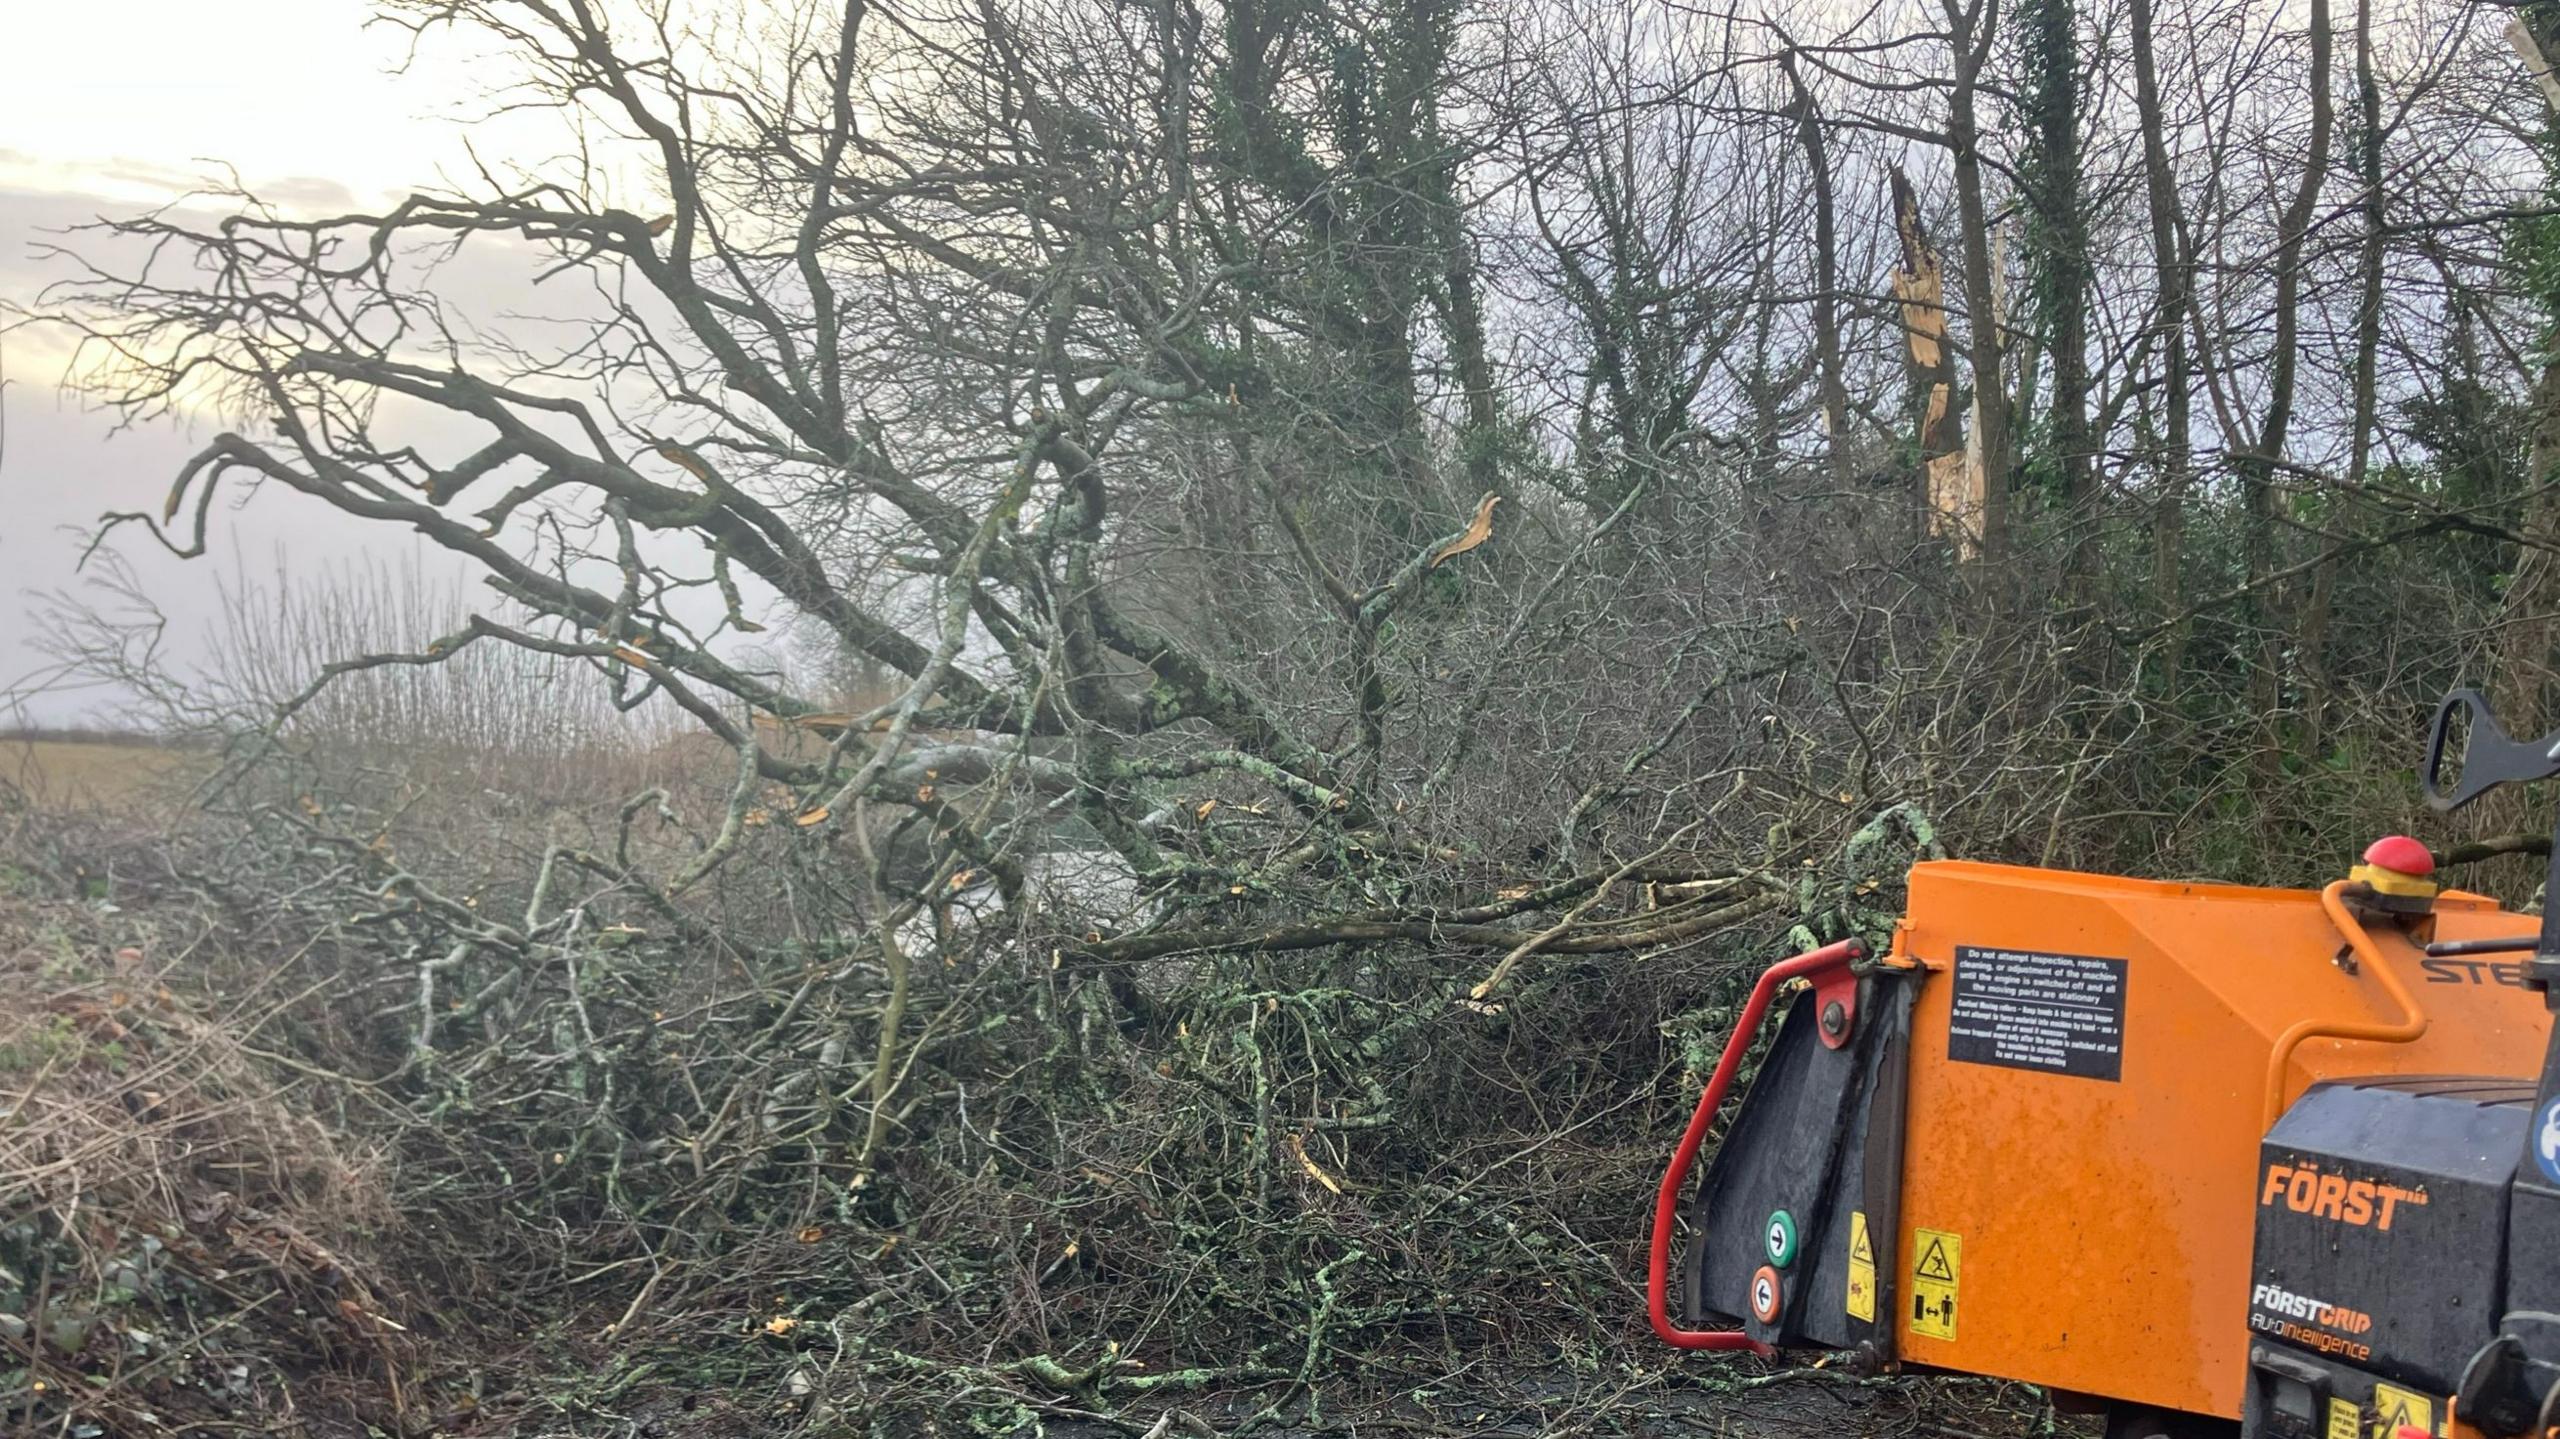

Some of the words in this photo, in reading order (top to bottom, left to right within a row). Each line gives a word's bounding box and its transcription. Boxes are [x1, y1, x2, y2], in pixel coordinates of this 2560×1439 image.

[1968, 949, 1980, 958] Do
[1998, 953, 2029, 962] attempt
[2031, 955, 2075, 967] inspection,
[2078, 960, 2108, 970] repairs,
[1960, 960, 1993, 972] cleaning,
[2008, 965, 2052, 974] adjustment
[2066, 970, 2080, 978] the
[2082, 972, 2117, 981] machine
[1979, 973, 1991, 981] the
[1994, 976, 2020, 984] engine
[2023, 977, 2030, 985] is
[2033, 979, 2069, 989] switched
[2072, 982, 2084, 990] off
[2087, 984, 2103, 992] and
[2105, 985, 2116, 993] all
[1972, 983, 1985, 991] the
[1988, 986, 2016, 996] moving
[2018, 988, 2039, 997] parts
[2042, 991, 2056, 999] are
[2059, 992, 2100, 1005] stationary
[2262, 1160, 2416, 1231] FÖRST
